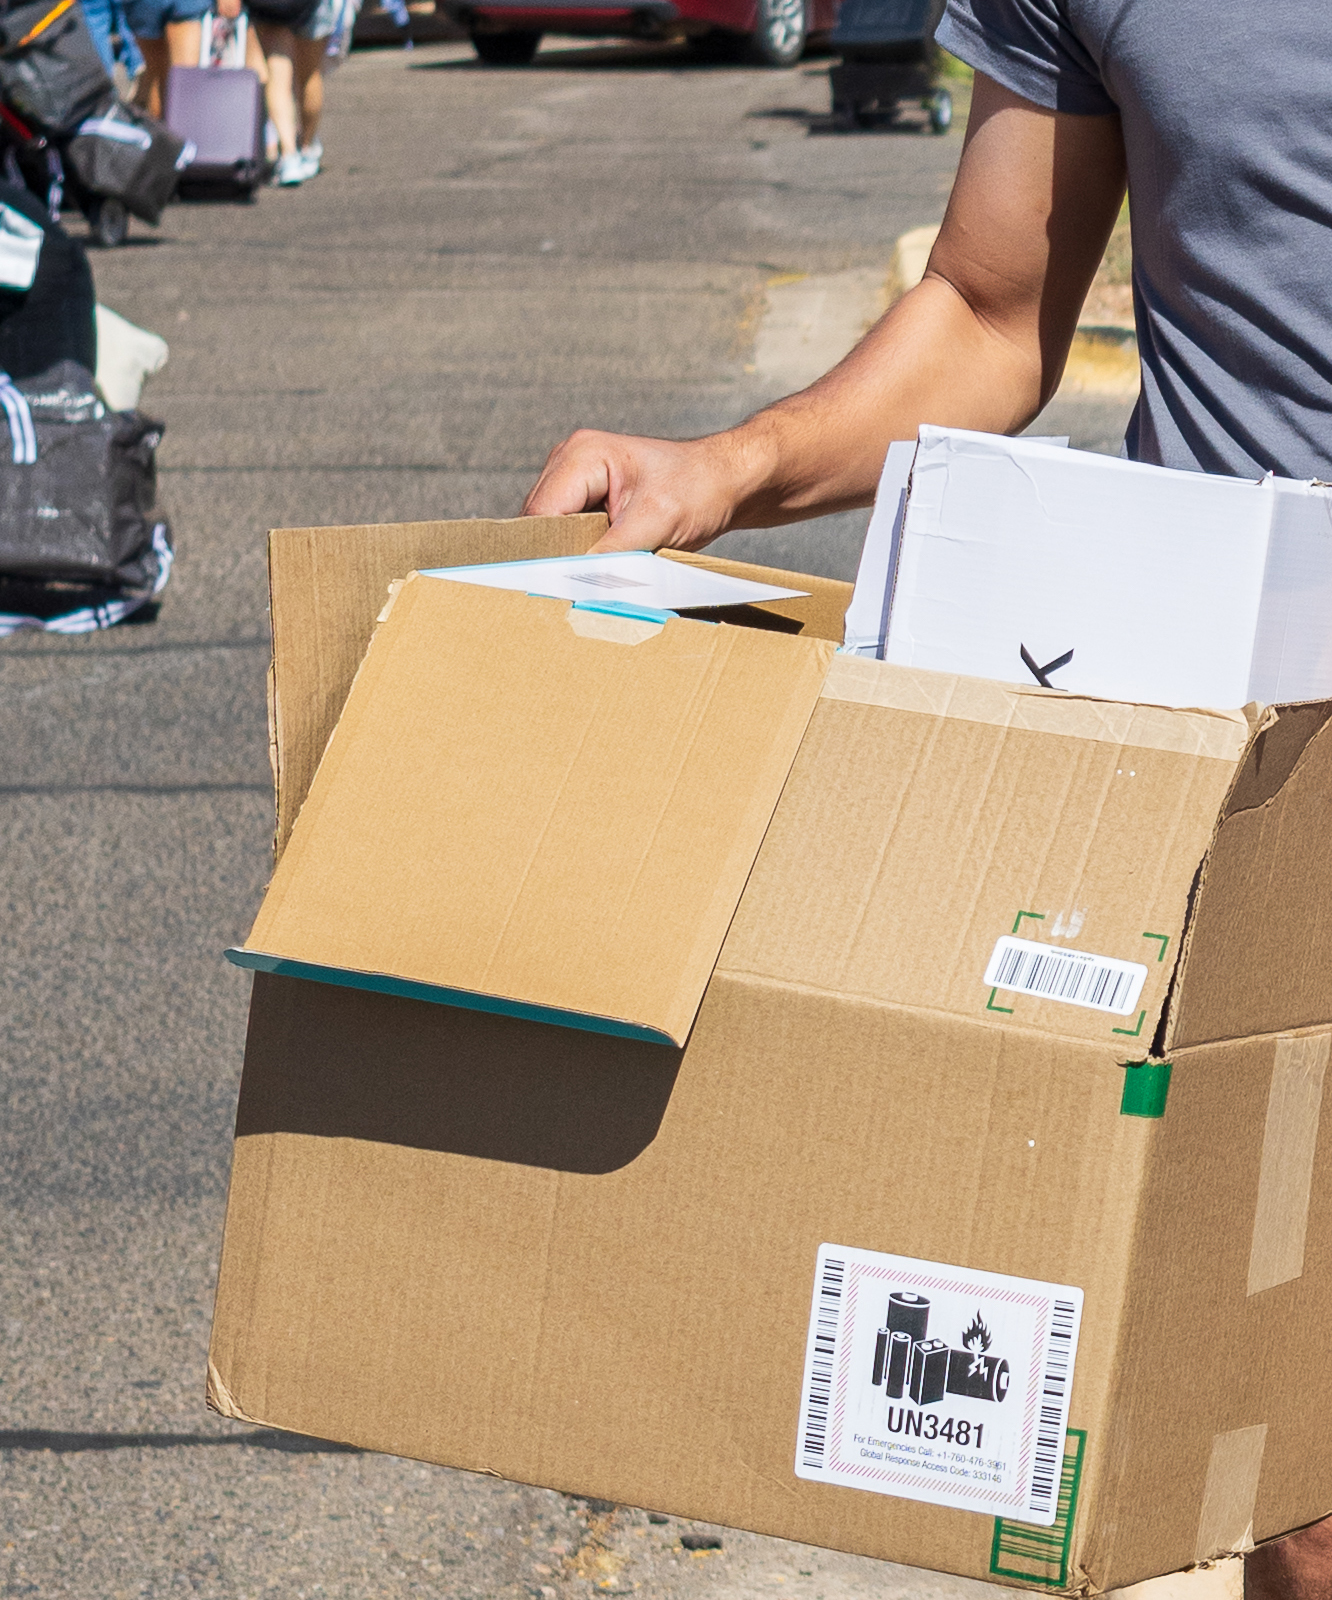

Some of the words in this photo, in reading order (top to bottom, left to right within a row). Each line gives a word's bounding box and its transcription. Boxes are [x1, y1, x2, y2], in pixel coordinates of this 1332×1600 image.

[887, 1406, 984, 1449] UN3481
[853, 1433, 866, 1444] For
[867, 1436, 916, 1454] Emergencies
[918, 1446, 935, 1457] Call:
[860, 1448, 884, 1460] Global
[885, 1453, 921, 1468] Response
[921, 1460, 947, 1473] Access
[949, 1466, 971, 1477] Code:
